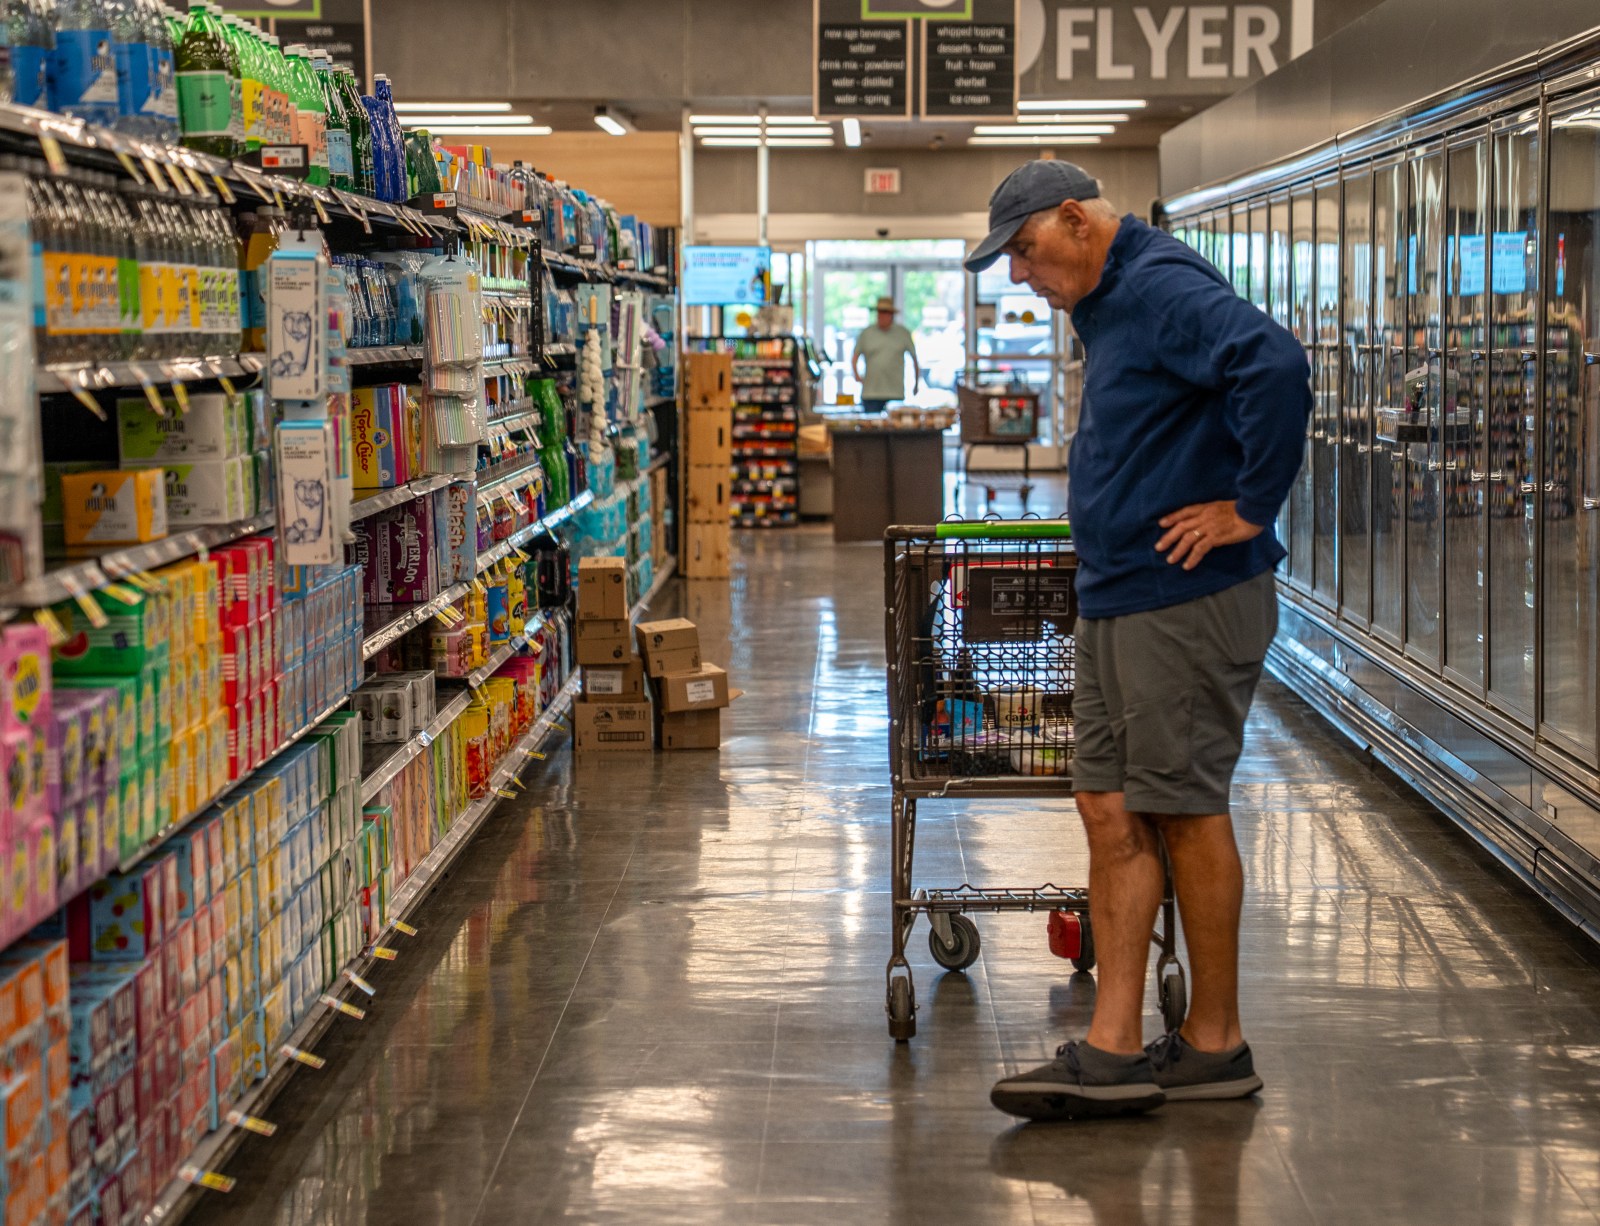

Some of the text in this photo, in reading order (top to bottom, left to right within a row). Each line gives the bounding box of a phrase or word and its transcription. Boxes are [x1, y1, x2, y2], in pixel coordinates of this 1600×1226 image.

[824, 28, 901, 41] new age beverages
[936, 27, 1005, 39] whipped topping
[849, 43, 876, 53] seltzer
[937, 43, 972, 53] desserts
[978, 43, 1005, 53] frozen
[1056, 5, 1281, 80] FLYER
[820, 60, 841, 70] drink
[842, 60, 858, 70] mix
[864, 60, 905, 72] powdered
[945, 60, 963, 70] fruit
[969, 60, 996, 70] frozen
[832, 77, 855, 87] water
[861, 76, 894, 87] distilled
[954, 76, 987, 87] sherbet
[834, 95, 858, 104] water
[864, 94, 891, 106] spring
[949, 94, 991, 104] ice cream
[355, 408, 373, 474] Topo Chico
[166, 484, 188, 497] OLAR
[381, 524, 390, 579] BLACK CHERRY
